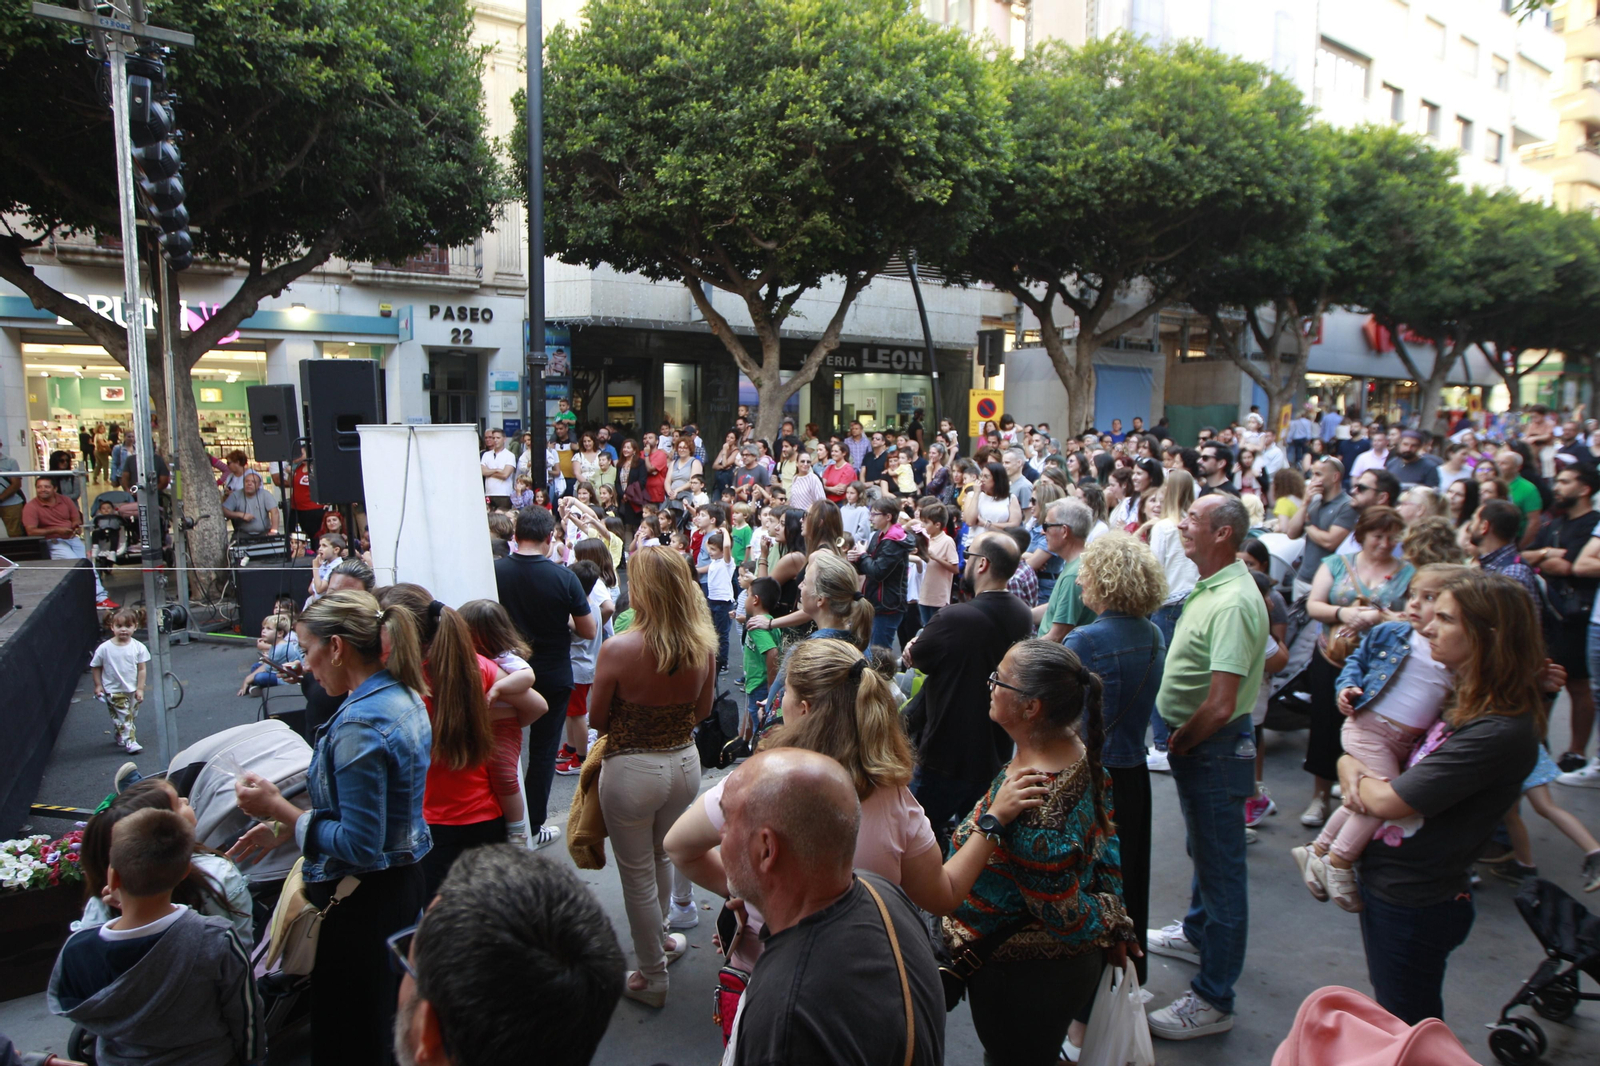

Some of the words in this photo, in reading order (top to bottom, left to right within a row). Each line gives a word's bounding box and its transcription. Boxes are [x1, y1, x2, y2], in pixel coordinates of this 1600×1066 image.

[429, 304, 493, 323] PASEO
[450, 327, 473, 345] 22
[800, 354, 857, 367] JERIA
[862, 347, 924, 371] LEON
